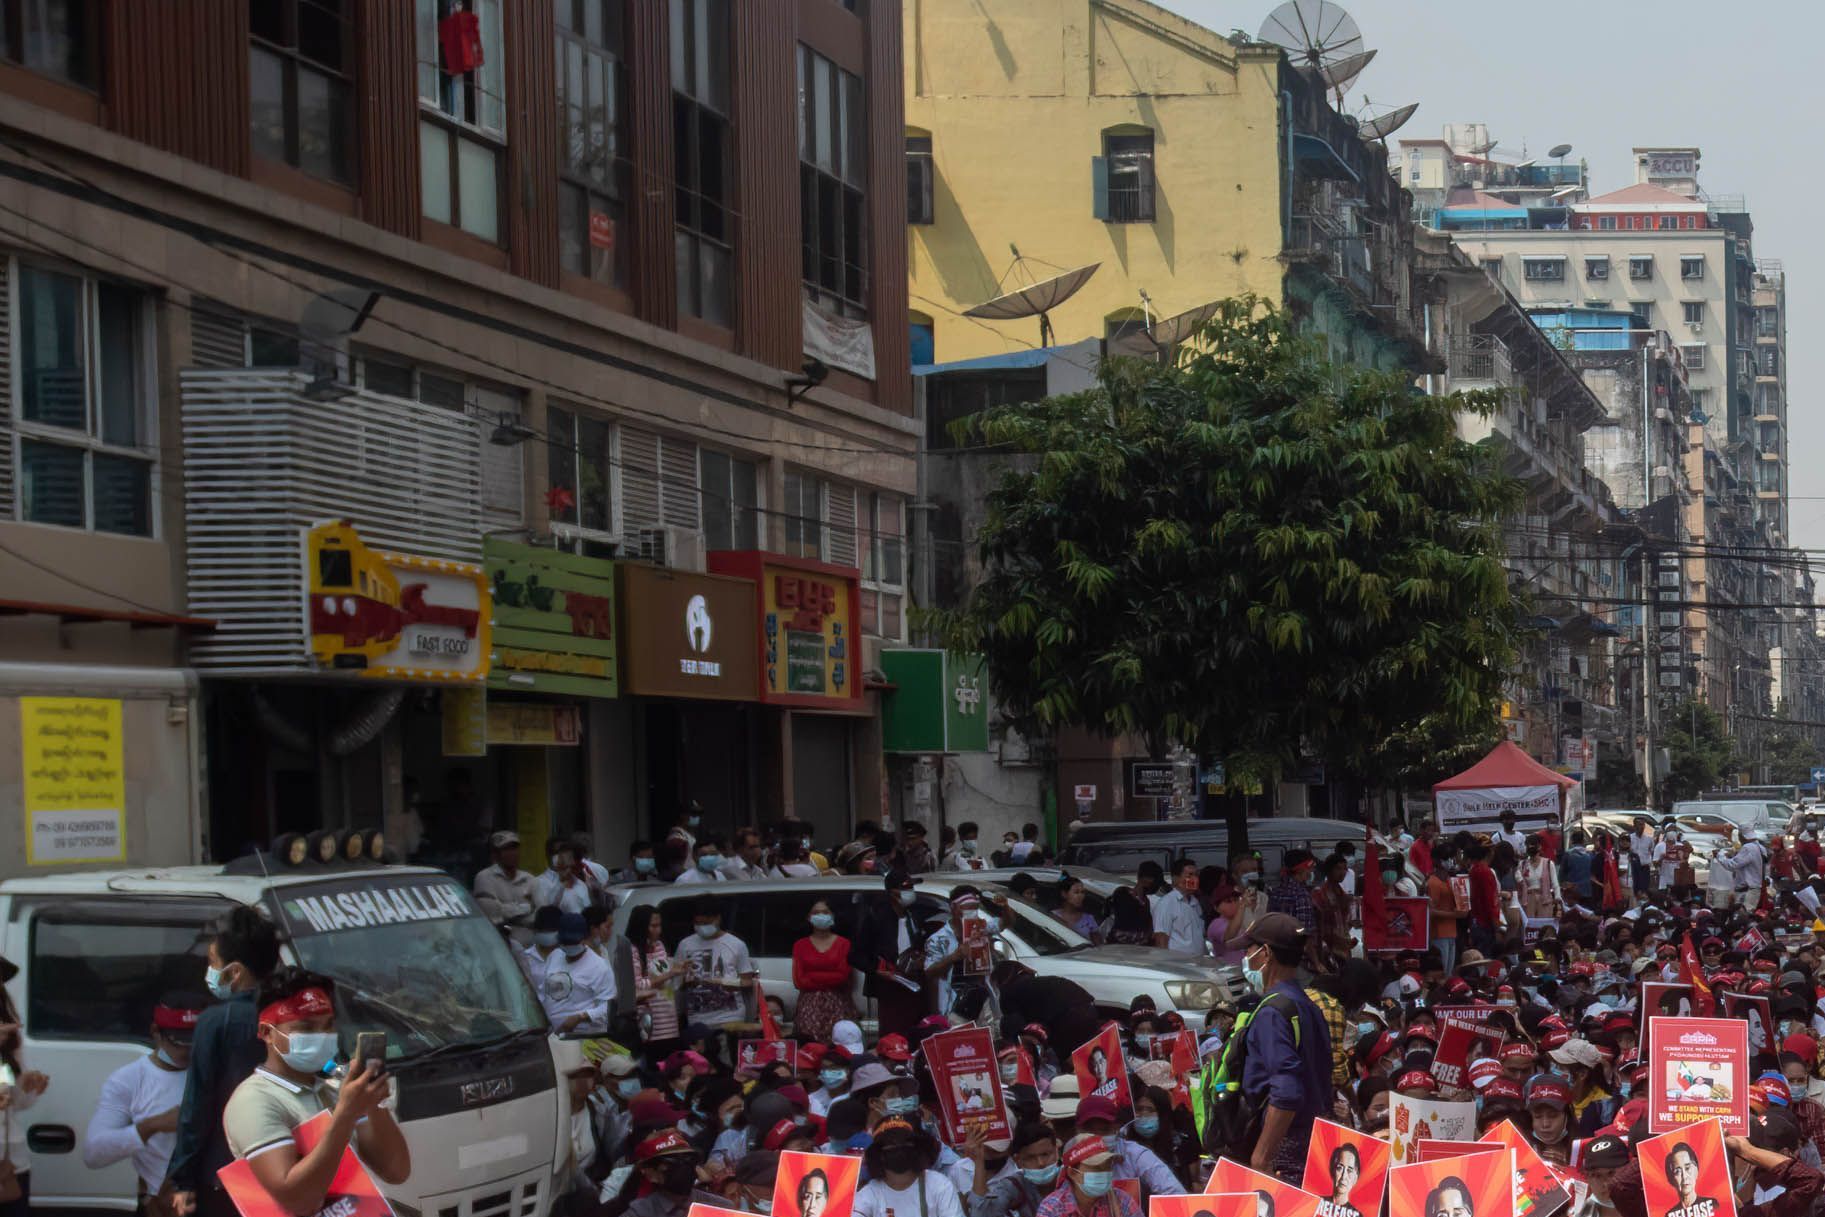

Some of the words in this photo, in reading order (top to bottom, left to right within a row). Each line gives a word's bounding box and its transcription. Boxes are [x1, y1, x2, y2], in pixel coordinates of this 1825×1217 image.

[417, 635, 440, 652] FAST
[443, 638, 468, 655] FOOD
[296, 883, 470, 931] MASHAALLAH
[1679, 1105, 1699, 1113] STAND
[1659, 1112, 1673, 1122] WE
